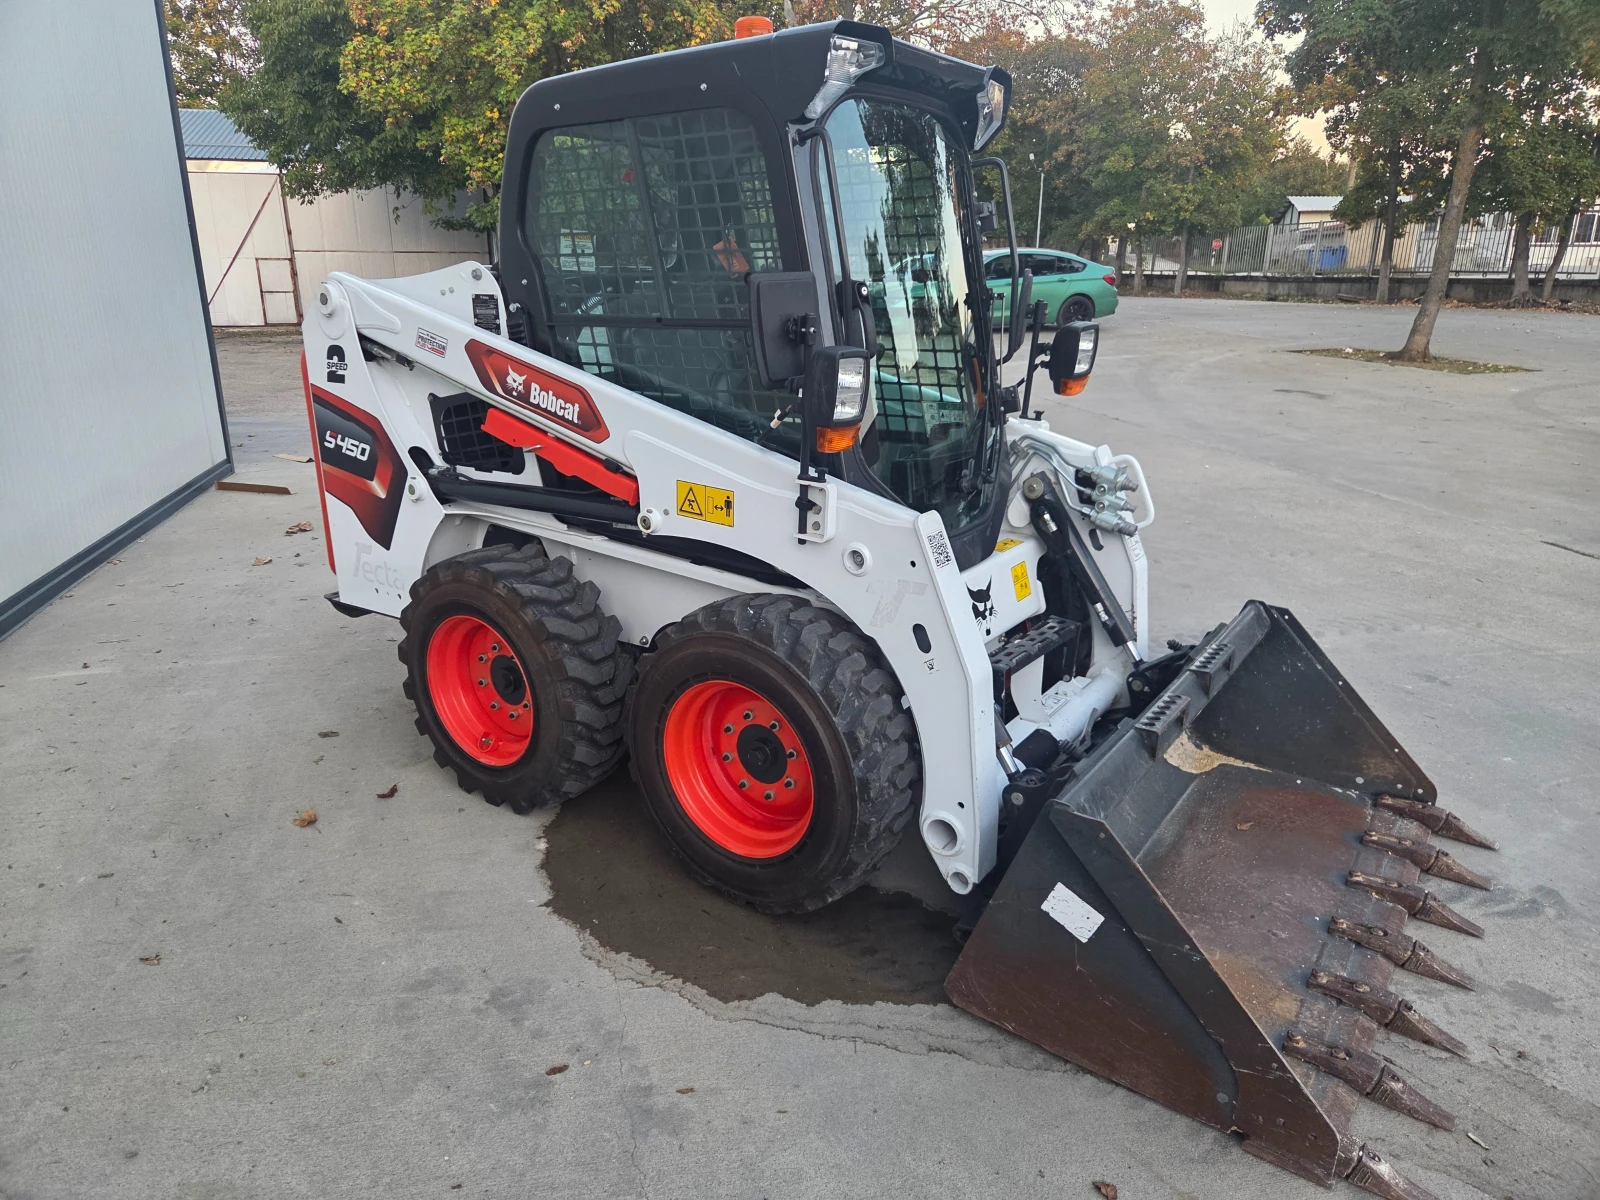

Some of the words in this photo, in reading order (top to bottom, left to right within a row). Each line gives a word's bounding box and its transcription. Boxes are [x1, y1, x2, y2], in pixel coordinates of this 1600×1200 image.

[418, 334, 446, 351] PROTECTION
[326, 361, 348, 371] SPEED
[529, 381, 580, 424] Bobcat
[323, 430, 371, 462] S450
